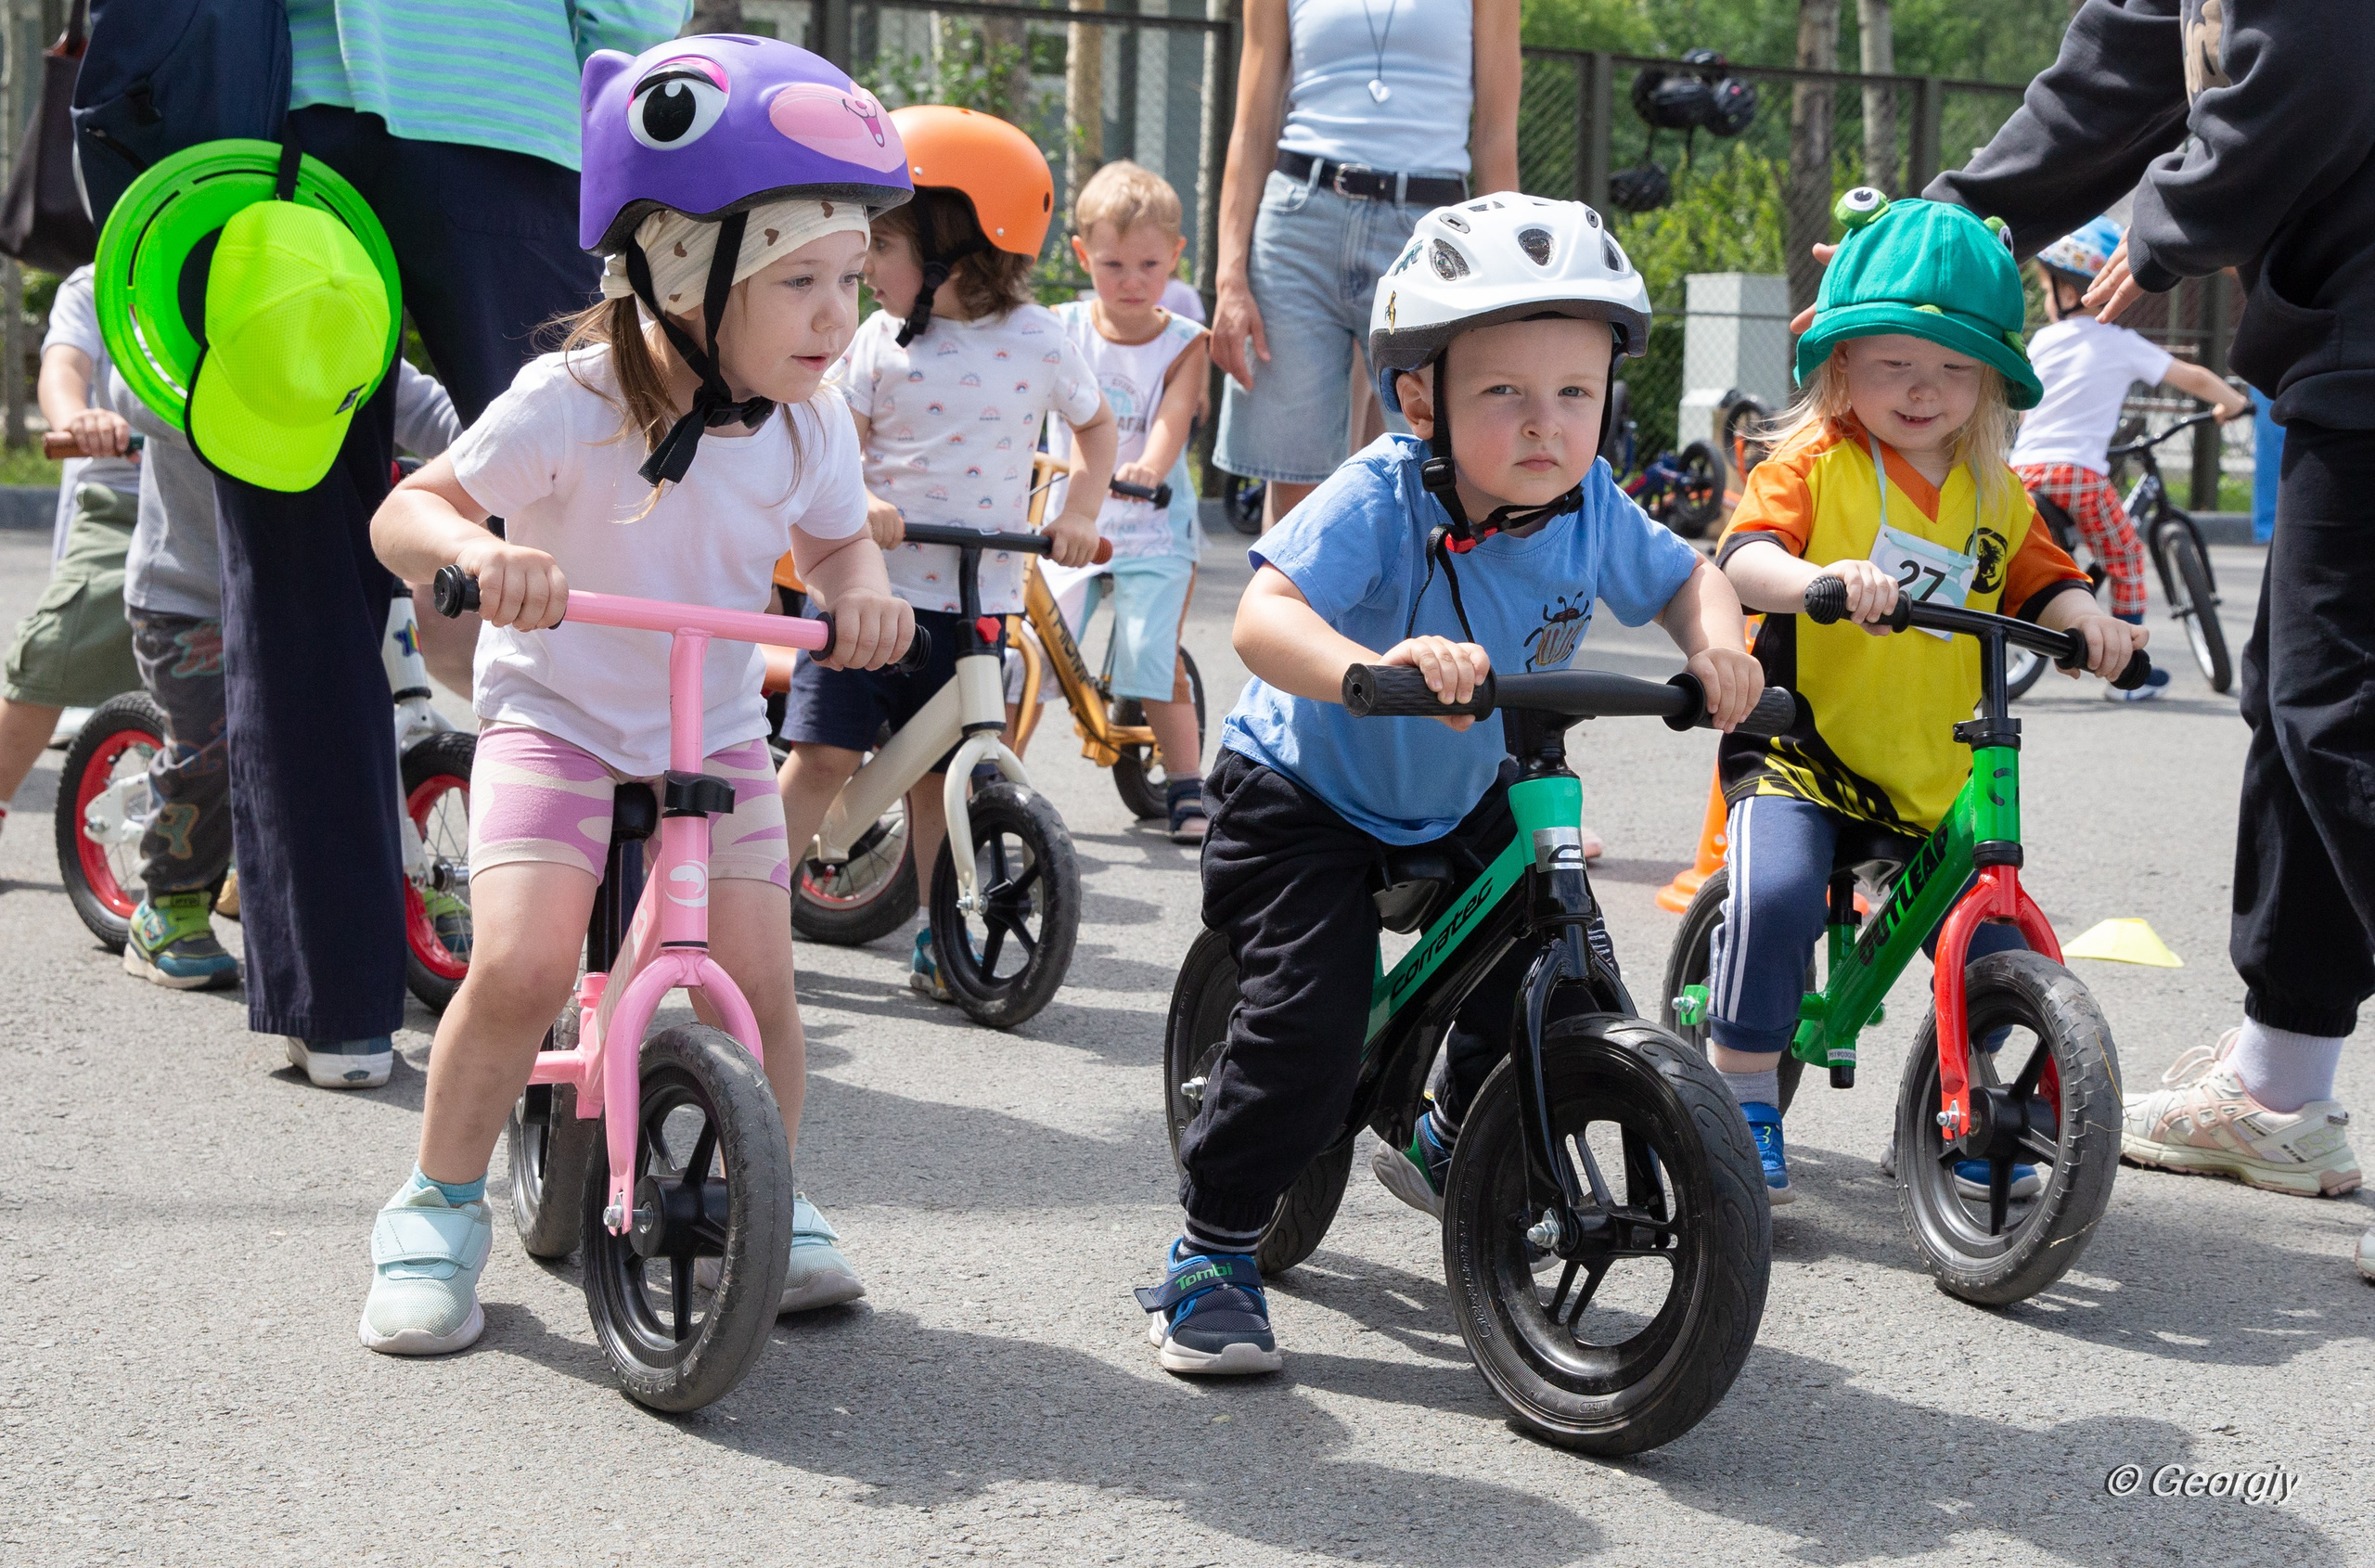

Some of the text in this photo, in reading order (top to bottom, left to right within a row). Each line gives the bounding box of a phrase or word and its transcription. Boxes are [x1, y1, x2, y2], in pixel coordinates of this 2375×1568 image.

[1898, 559, 1946, 601] 27
[1859, 823, 1948, 966] OUTLEAP
[1392, 877, 1494, 1001] corratec
[1175, 1263, 1233, 1291] Tombi
